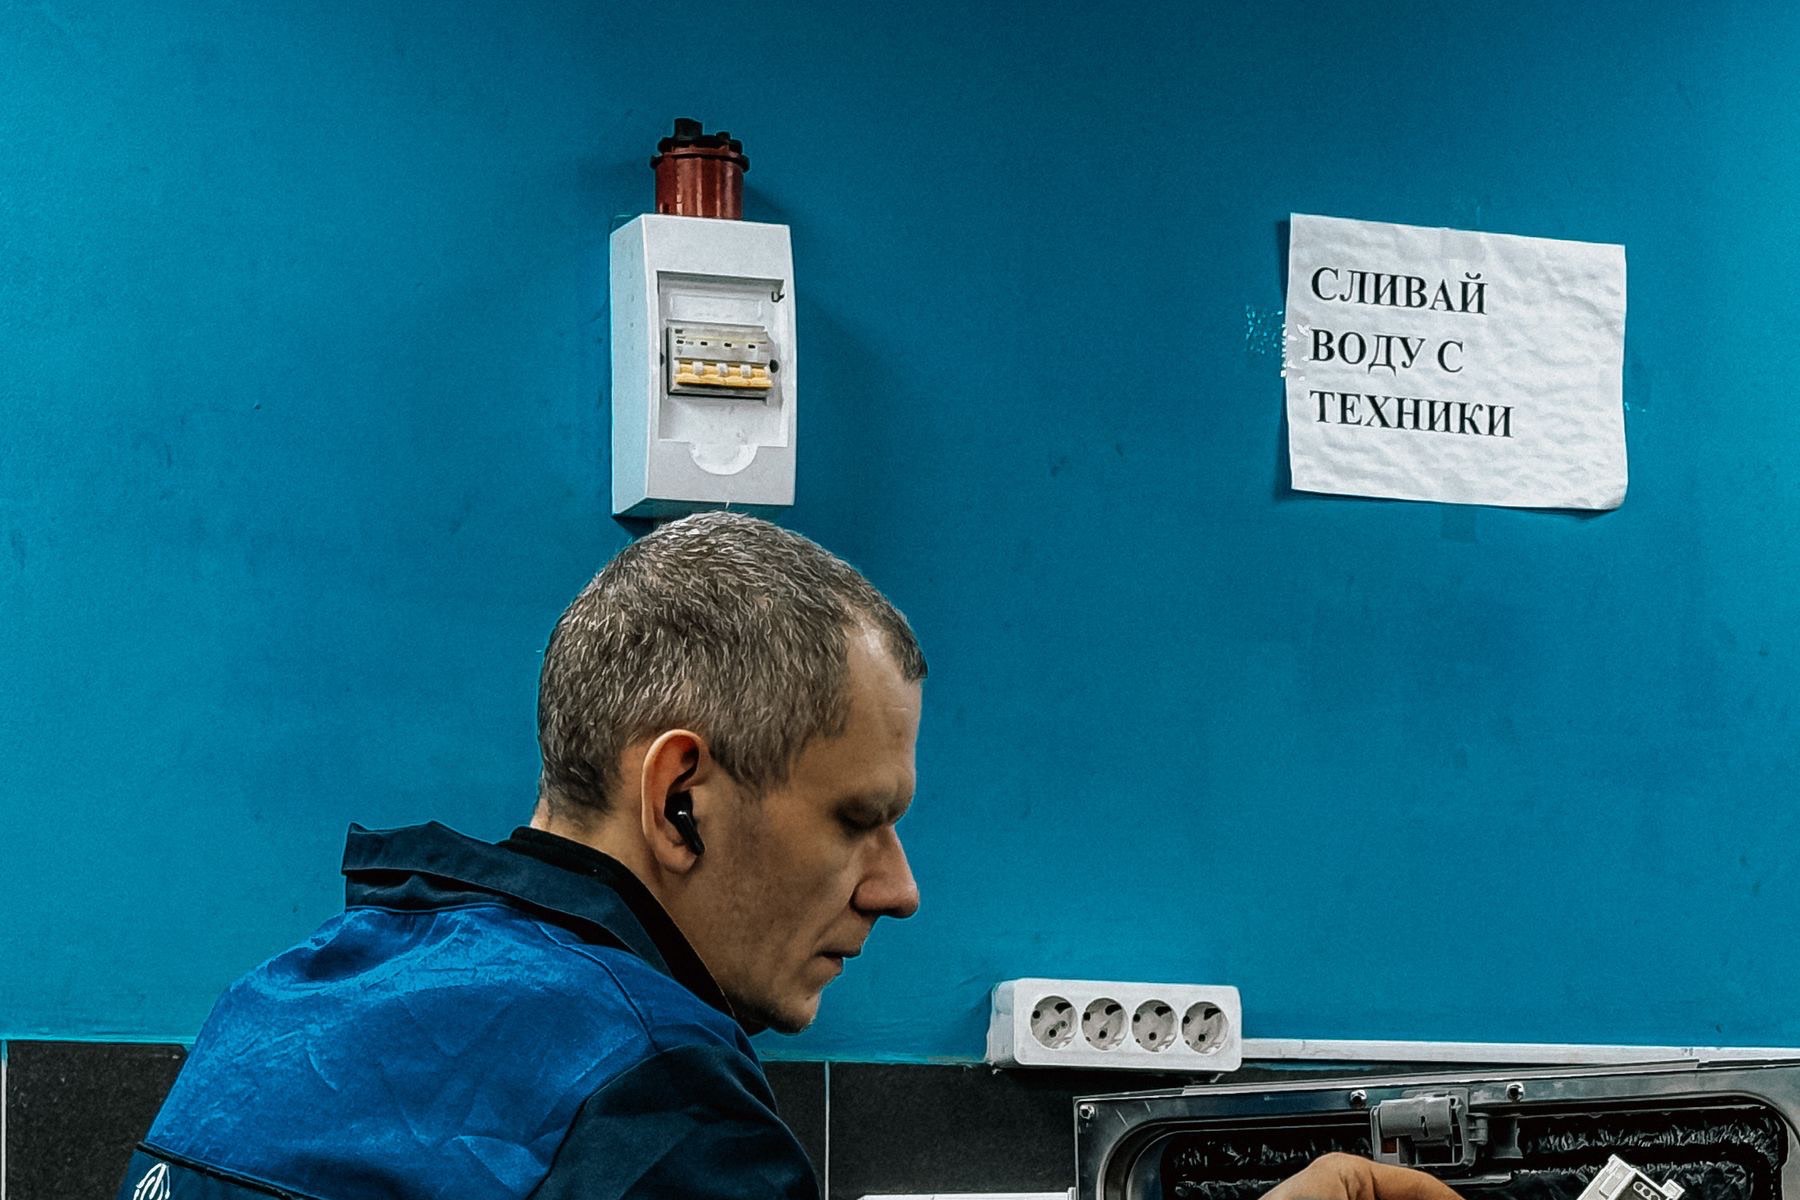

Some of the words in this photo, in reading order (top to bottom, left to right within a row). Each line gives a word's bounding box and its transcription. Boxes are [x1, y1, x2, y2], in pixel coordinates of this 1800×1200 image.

[1311, 267, 1488, 315] СЛИВАЙ
[1309, 328, 1426, 376] ВОДУ
[1437, 340, 1464, 373] С
[1309, 390, 1514, 438] ТЕХНИКИ
